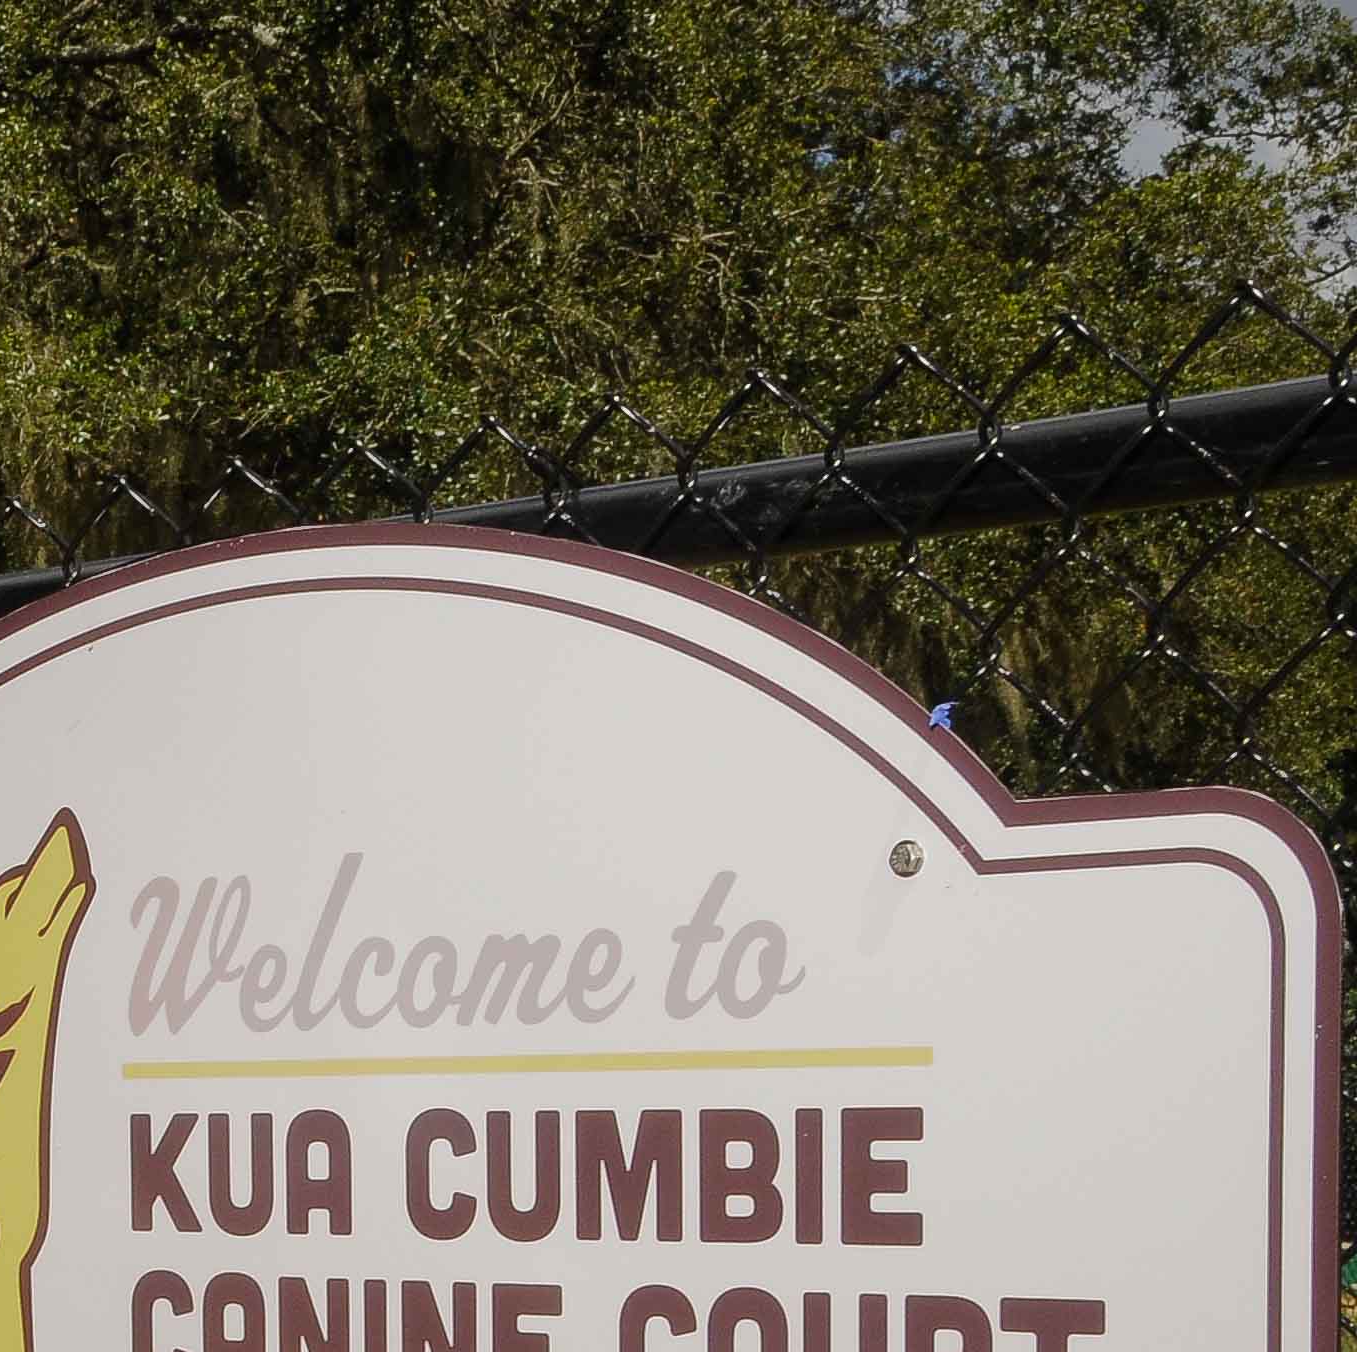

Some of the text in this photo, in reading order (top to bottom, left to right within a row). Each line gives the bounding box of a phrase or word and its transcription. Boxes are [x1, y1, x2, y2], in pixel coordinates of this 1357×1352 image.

[128, 853, 806, 1037] Welcome to
[130, 1107, 923, 1246] KUA CUMBIE
